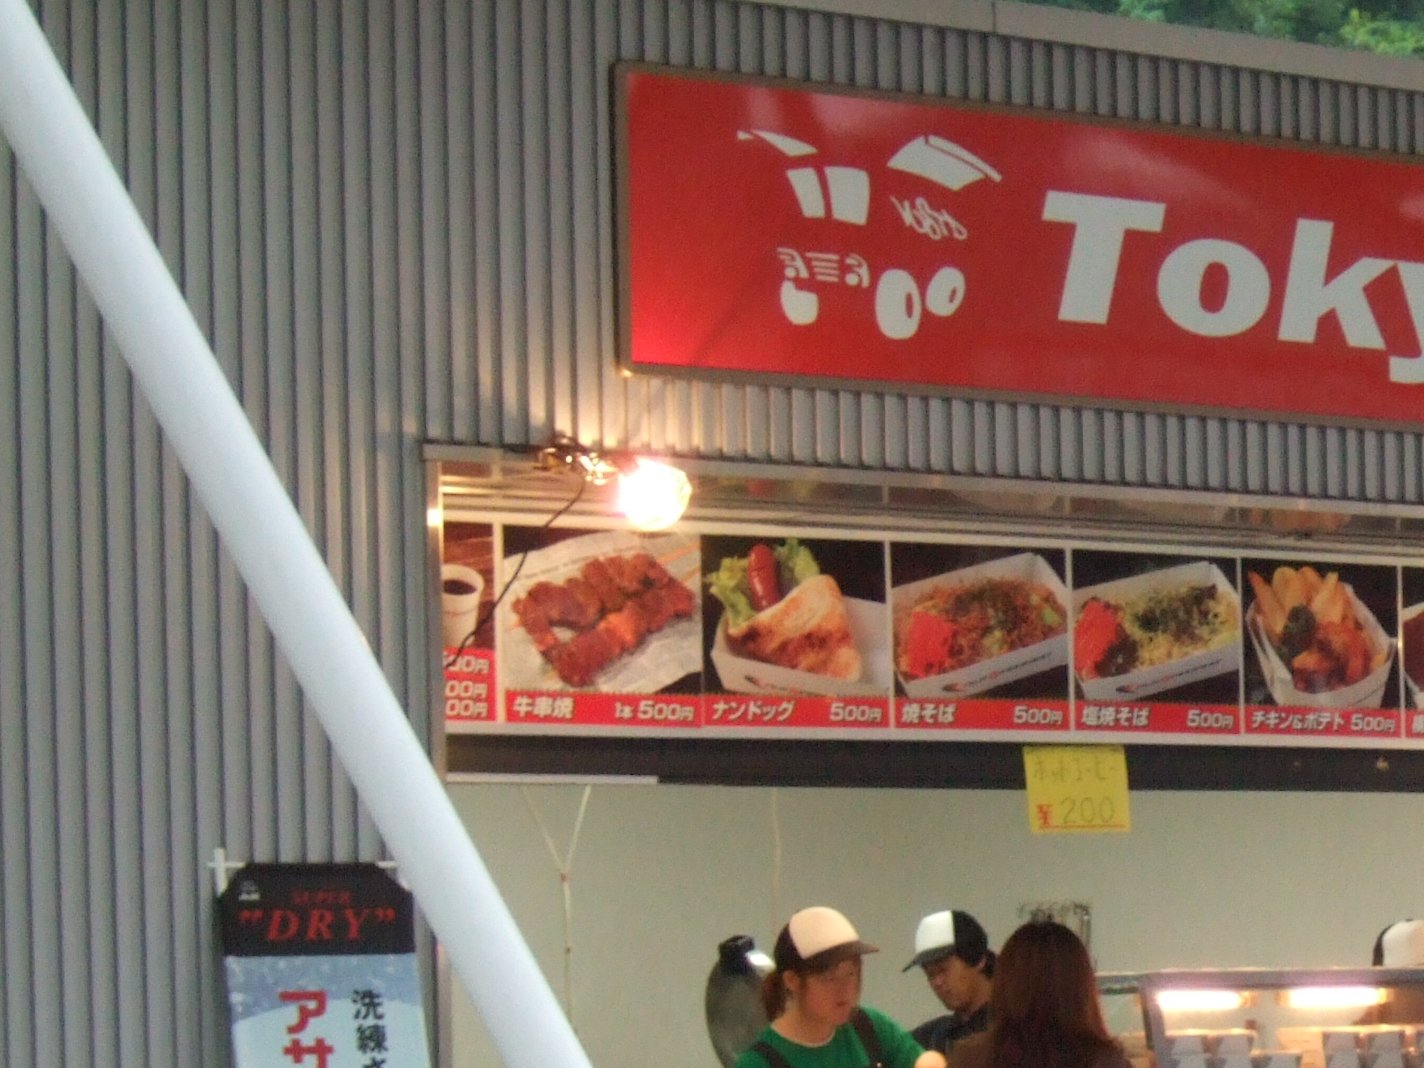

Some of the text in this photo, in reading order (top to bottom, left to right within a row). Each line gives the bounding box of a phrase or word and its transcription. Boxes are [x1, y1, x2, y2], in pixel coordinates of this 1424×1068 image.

[637, 699, 695, 722] 500円
[829, 703, 882, 723] 500円
[901, 704, 1063, 725] 焼そば 500円
[1081, 707, 1234, 730] 塩焼そば 500円
[1350, 713, 1396, 733] 500円
